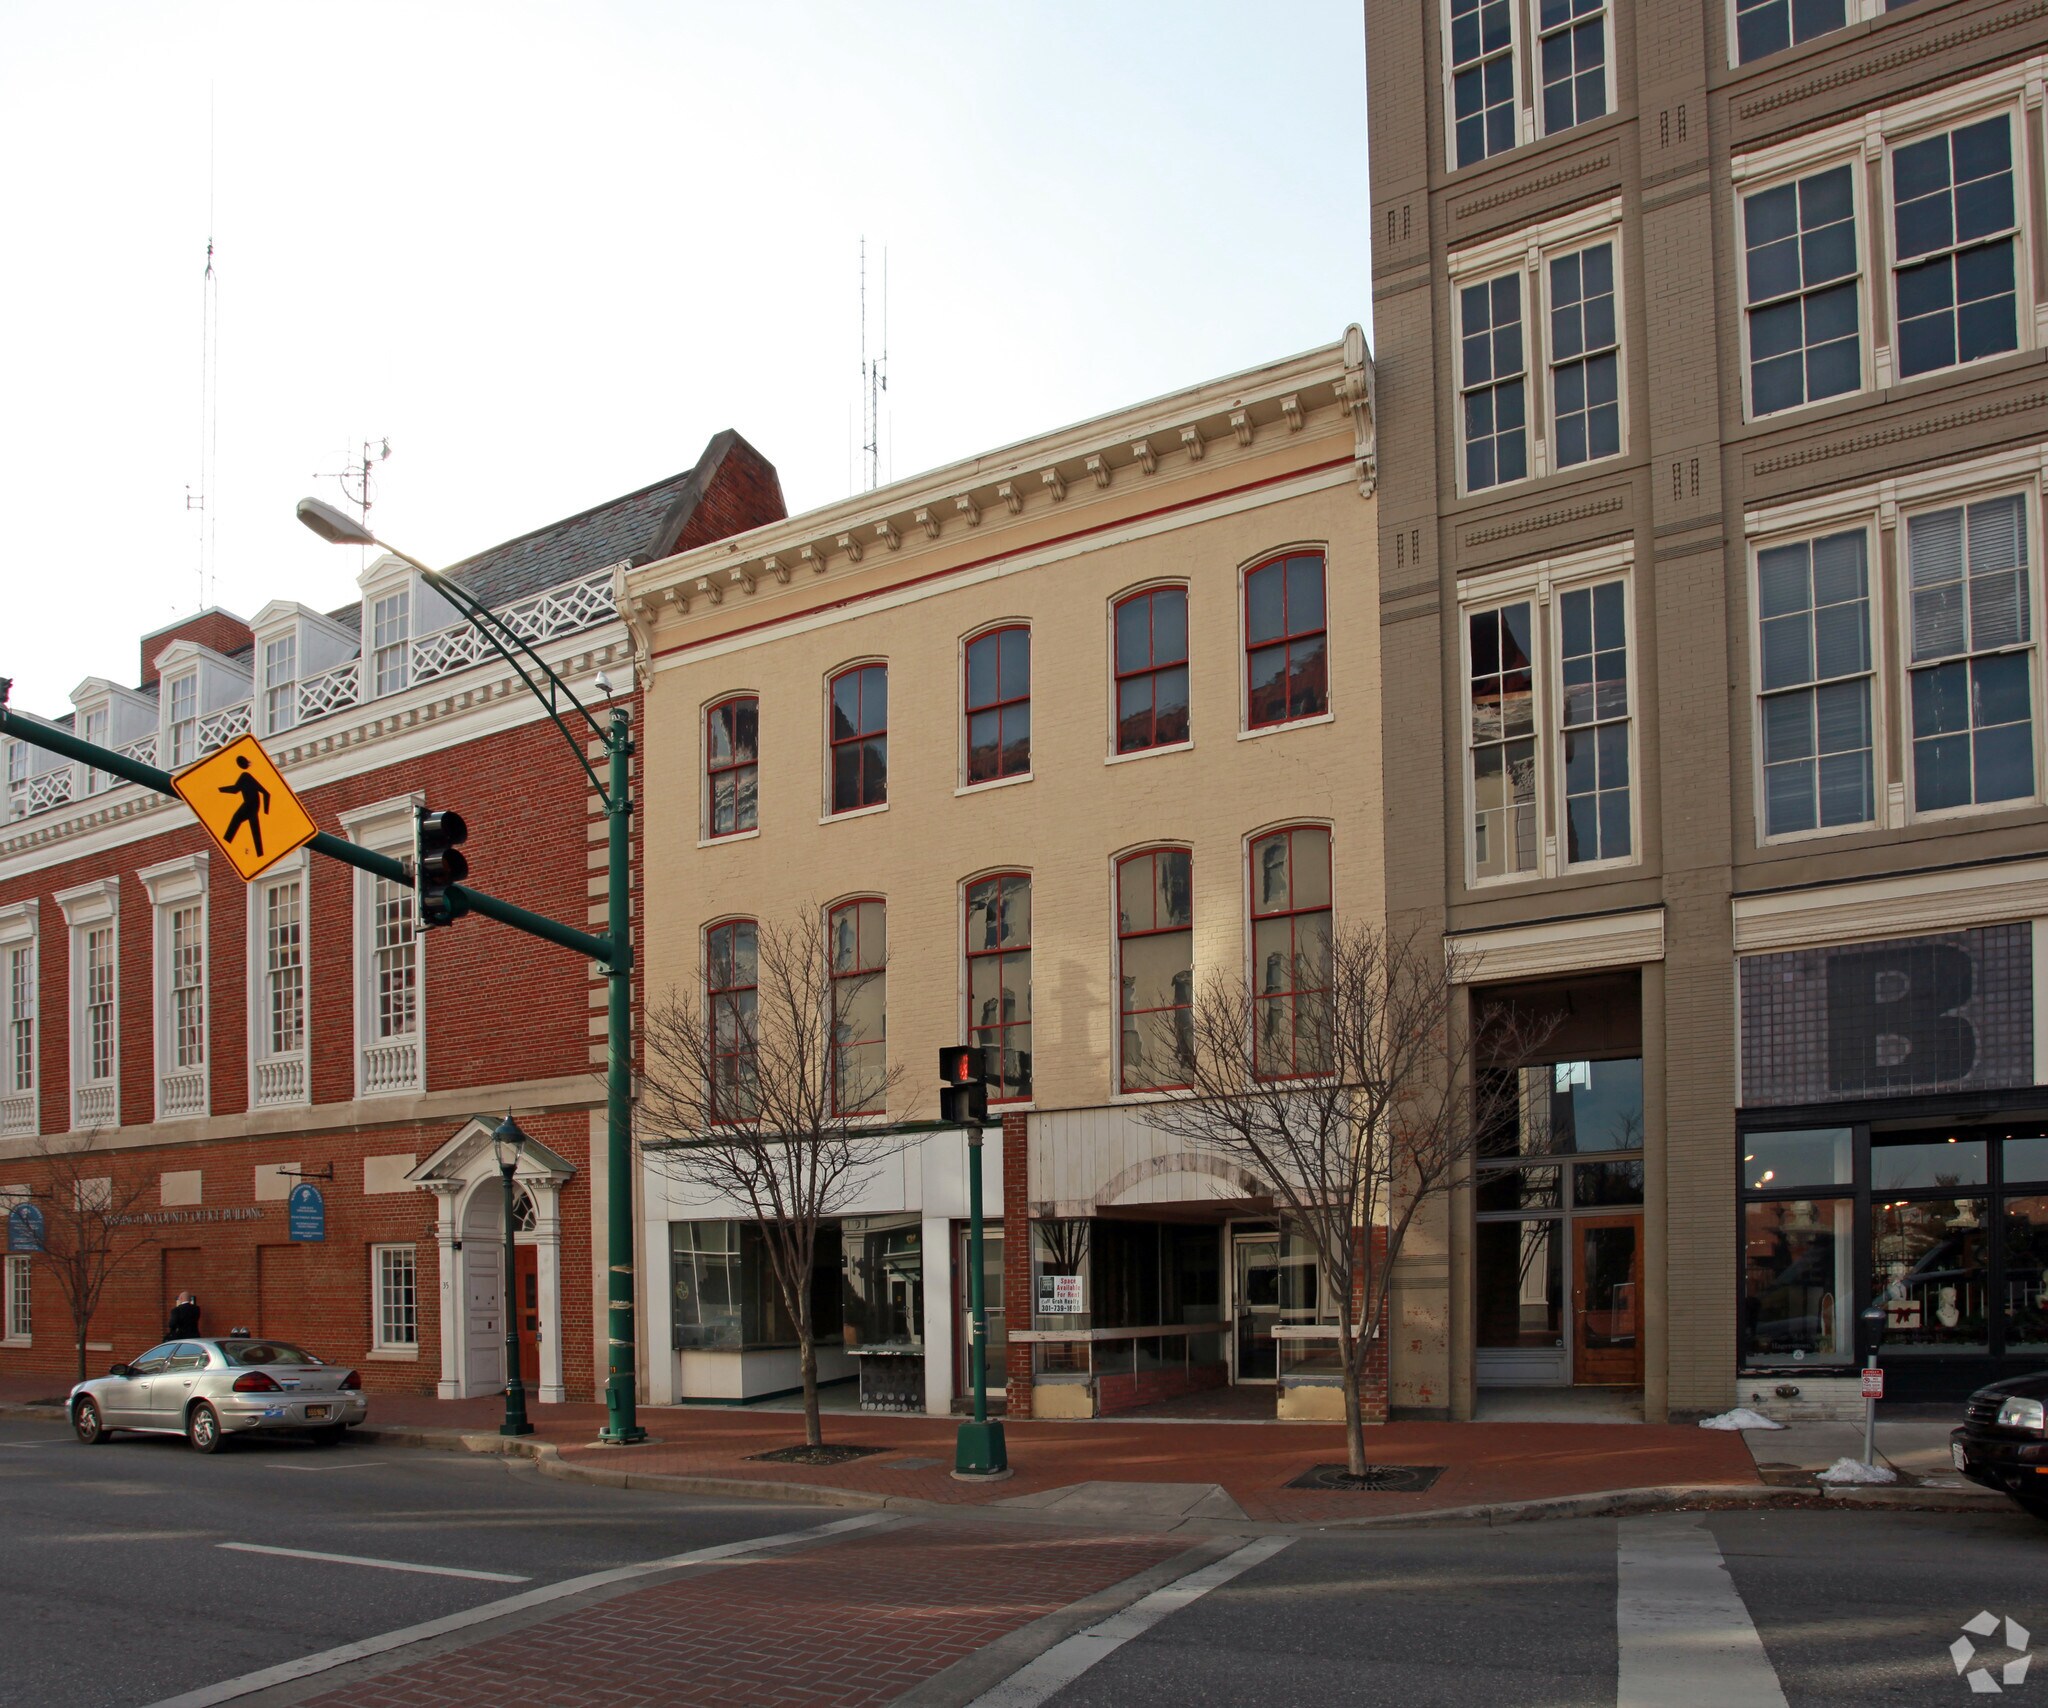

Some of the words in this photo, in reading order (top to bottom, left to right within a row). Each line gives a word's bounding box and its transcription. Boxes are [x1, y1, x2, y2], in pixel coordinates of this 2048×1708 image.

[1827, 944, 1976, 1091] B
[152, 1211, 189, 1225] COUNTY
[191, 1209, 221, 1223] OFFICE
[223, 1207, 265, 1221] BUILDING
